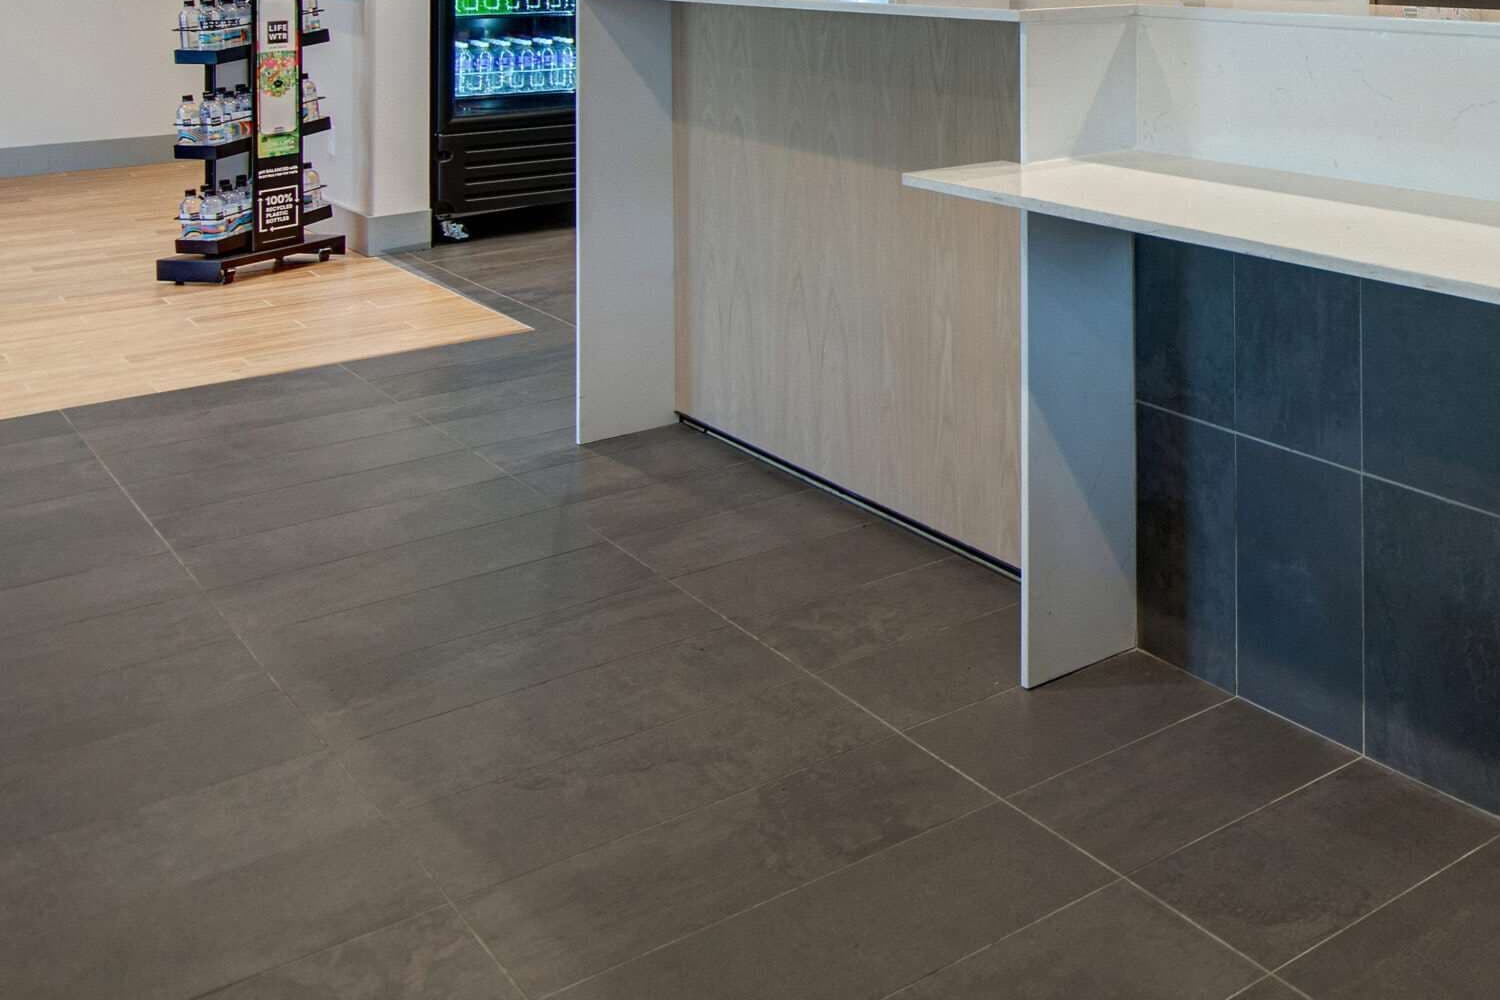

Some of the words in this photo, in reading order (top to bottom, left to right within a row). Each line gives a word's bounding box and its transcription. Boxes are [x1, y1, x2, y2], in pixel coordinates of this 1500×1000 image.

[269, 24, 287, 32] LIFE
[265, 193, 293, 205] 100%
[266, 203, 293, 212] RECYCLED
[266, 210, 288, 218] PLASTIC
[265, 216, 289, 224] BOTTLES
